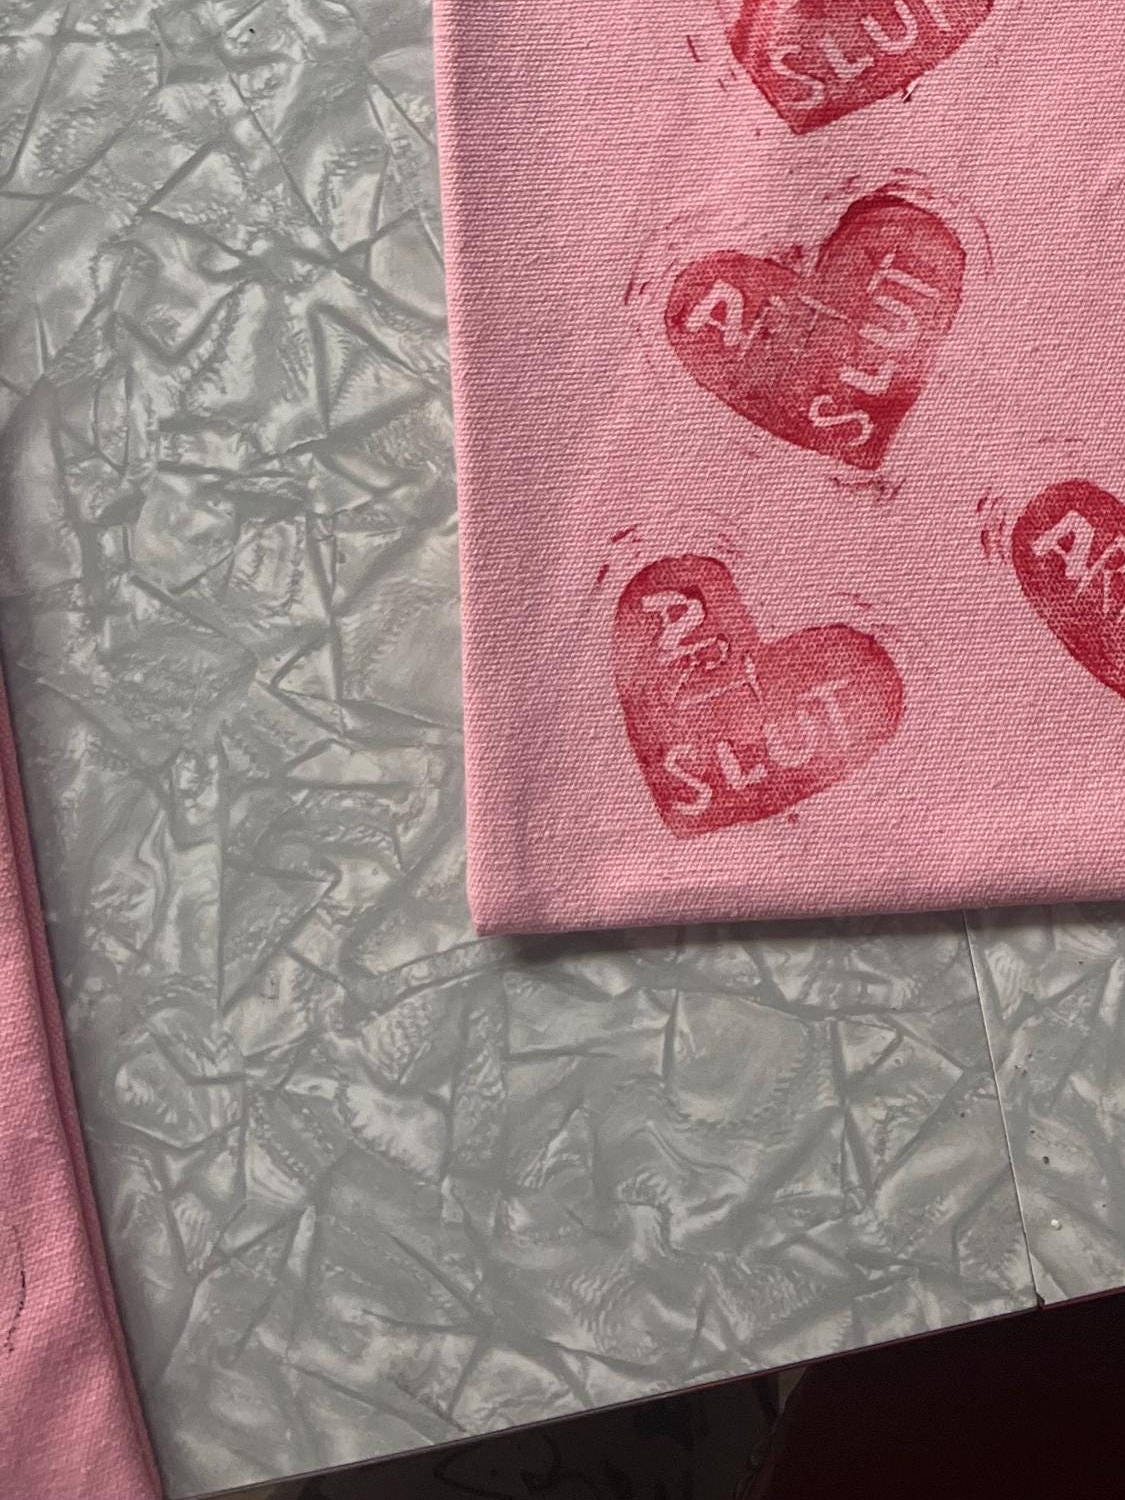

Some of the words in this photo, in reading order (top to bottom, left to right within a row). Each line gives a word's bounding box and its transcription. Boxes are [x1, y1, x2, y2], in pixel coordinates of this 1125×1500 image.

[808, 252, 944, 448] SLUT
[640, 589, 764, 708] ART
[664, 678, 851, 817] SLUT
